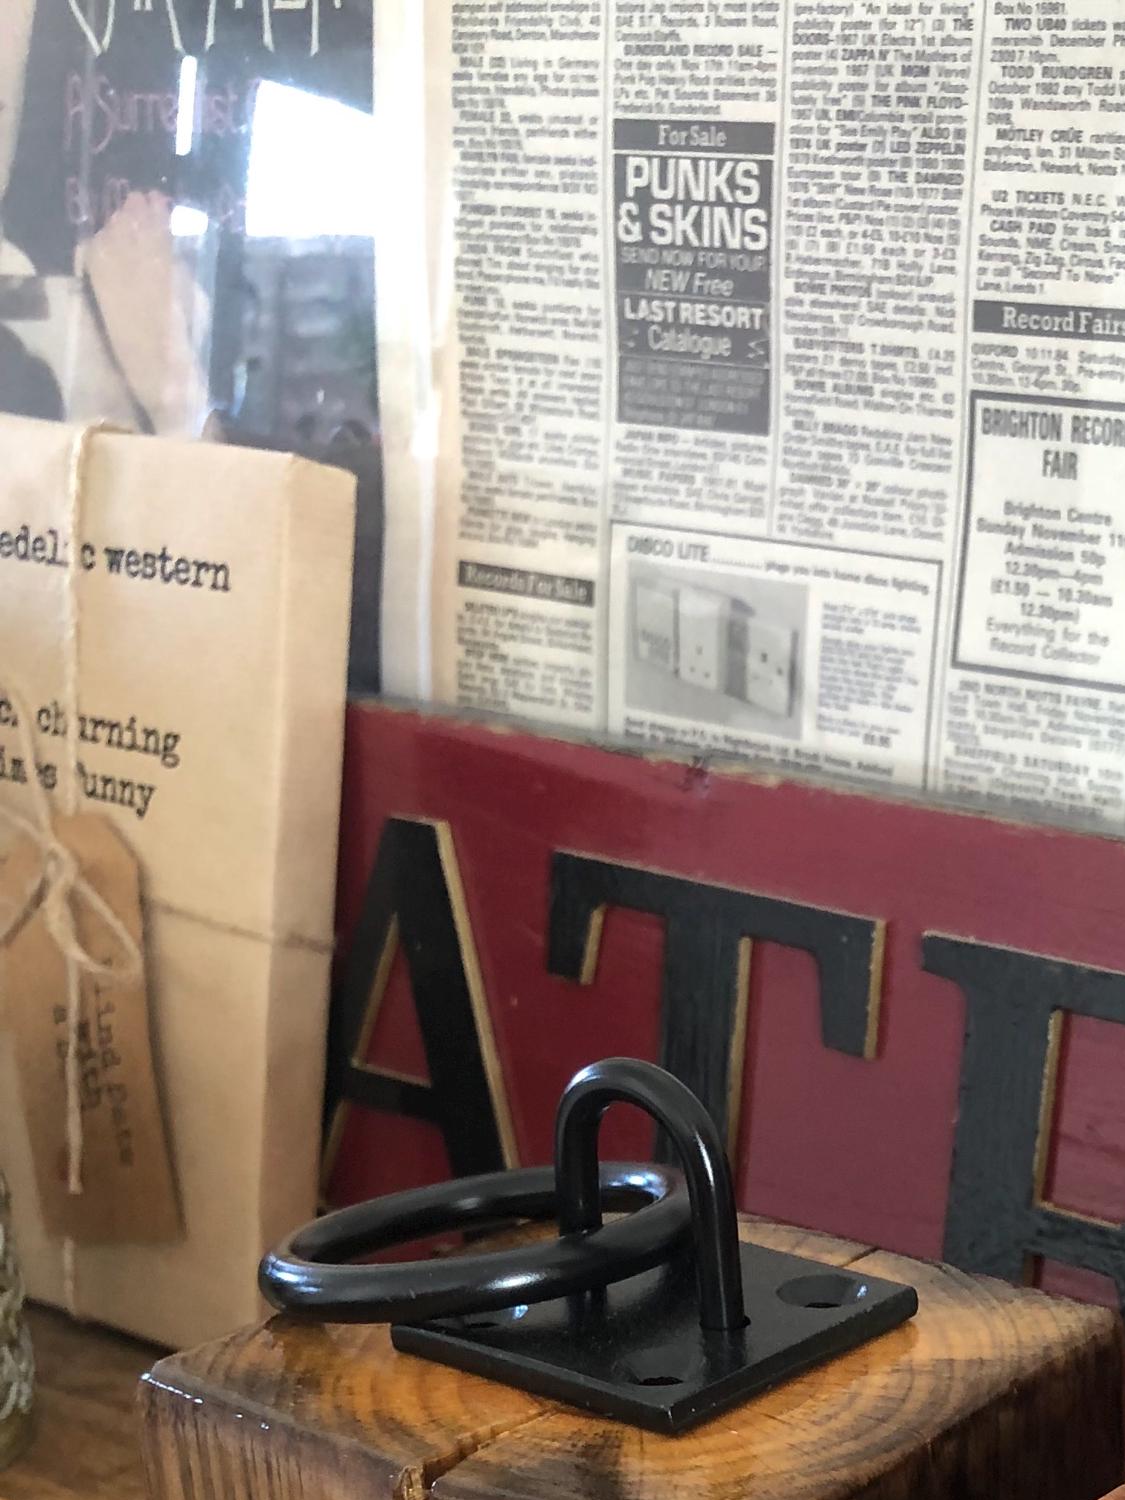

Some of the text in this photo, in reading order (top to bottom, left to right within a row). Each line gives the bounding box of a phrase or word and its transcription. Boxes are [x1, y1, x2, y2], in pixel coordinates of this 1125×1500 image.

[658, 124, 727, 147] For Sale
[625, 156, 760, 204] PUNKS
[618, 202, 768, 250] & SKINS
[645, 268, 734, 296] NEW Free
[624, 298, 763, 329] LAST RESORT
[1002, 306, 1075, 332] Record
[982, 407, 1063, 441] BRIGHTON
[1042, 449, 1078, 480] FAIR
[0, 524, 231, 592] edelc western
